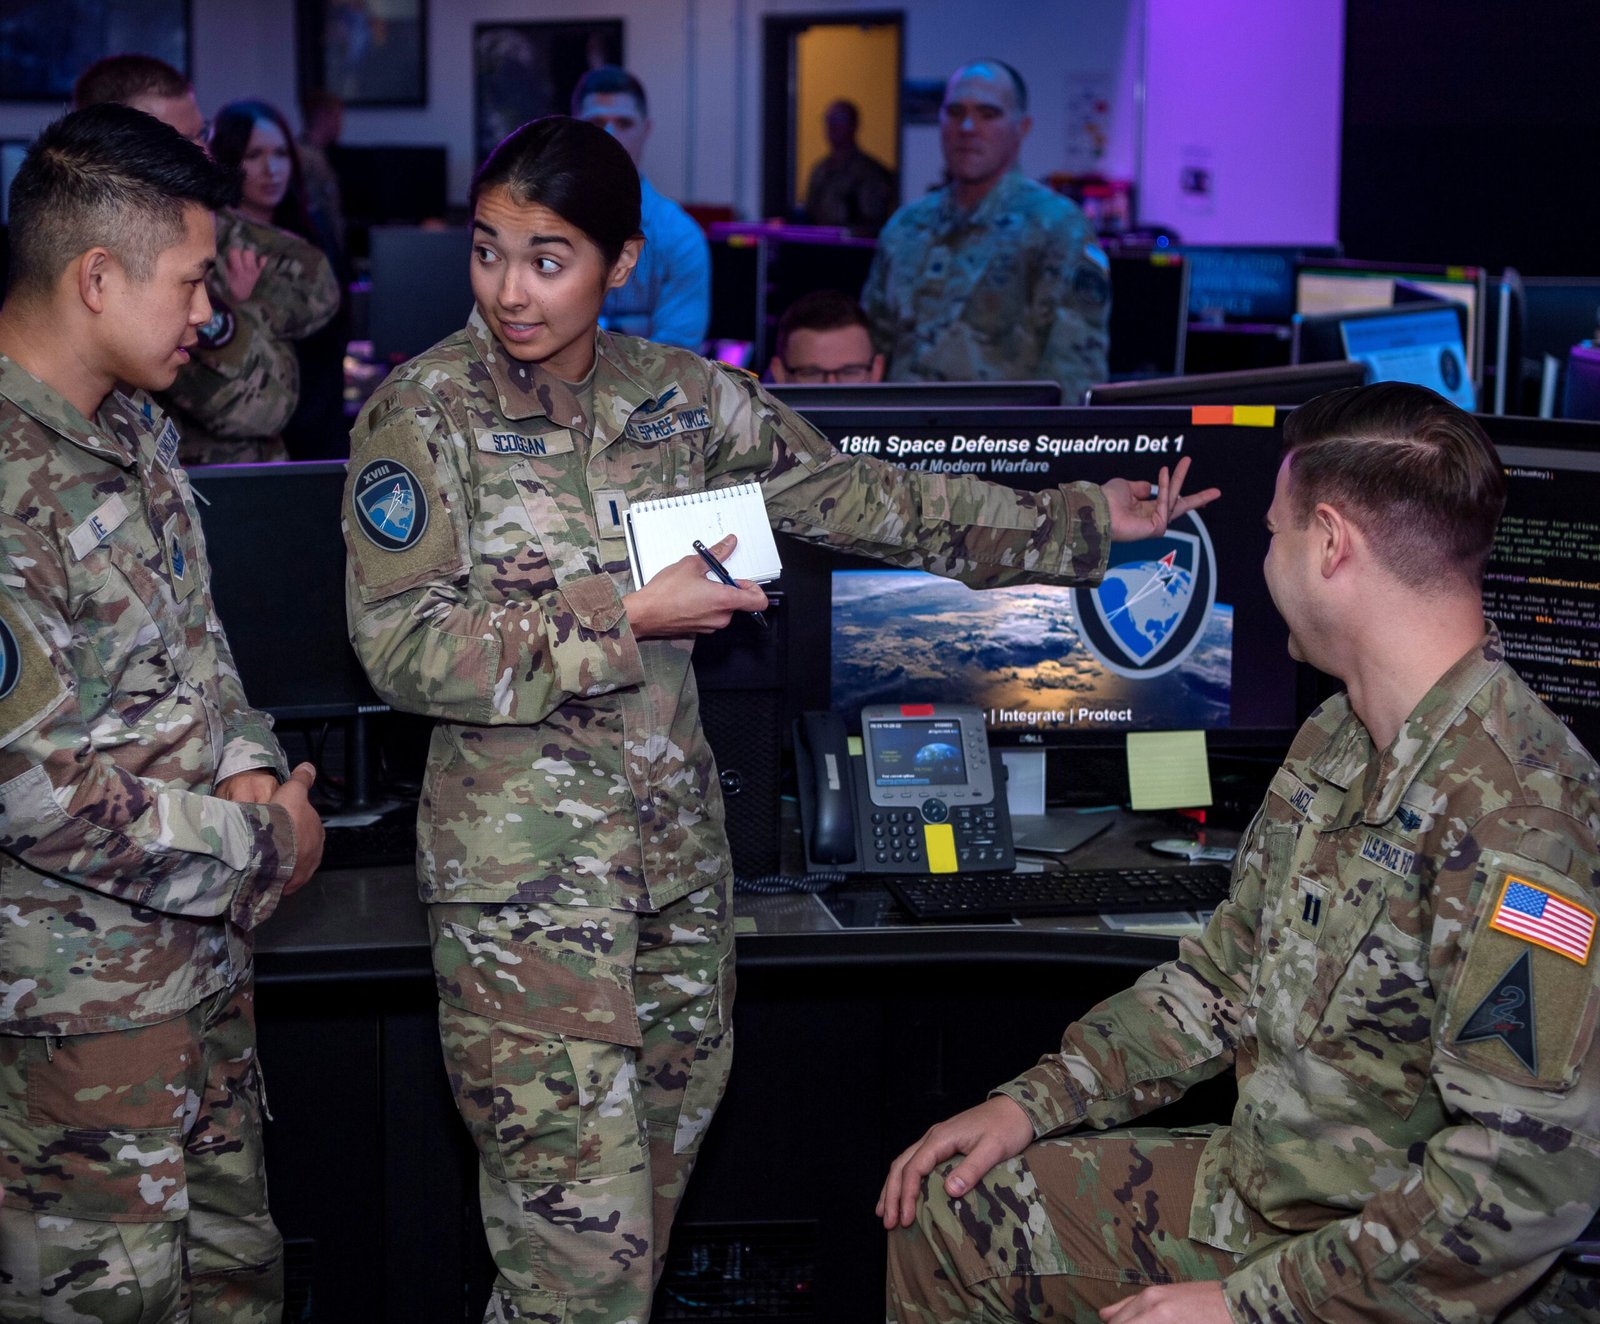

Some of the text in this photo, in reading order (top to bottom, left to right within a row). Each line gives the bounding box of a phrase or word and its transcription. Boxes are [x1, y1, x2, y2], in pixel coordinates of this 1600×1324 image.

[638, 416, 676, 440] SPACE
[677, 407, 709, 429] FORCE
[839, 435, 1184, 456] 18th Space Defense Squadron Det 1
[363, 464, 391, 485] XVIII
[929, 459, 987, 473] Modern
[990, 459, 1050, 473] Warfare
[1000, 709, 1065, 725] Integrate
[1078, 708, 1132, 722] Protect
